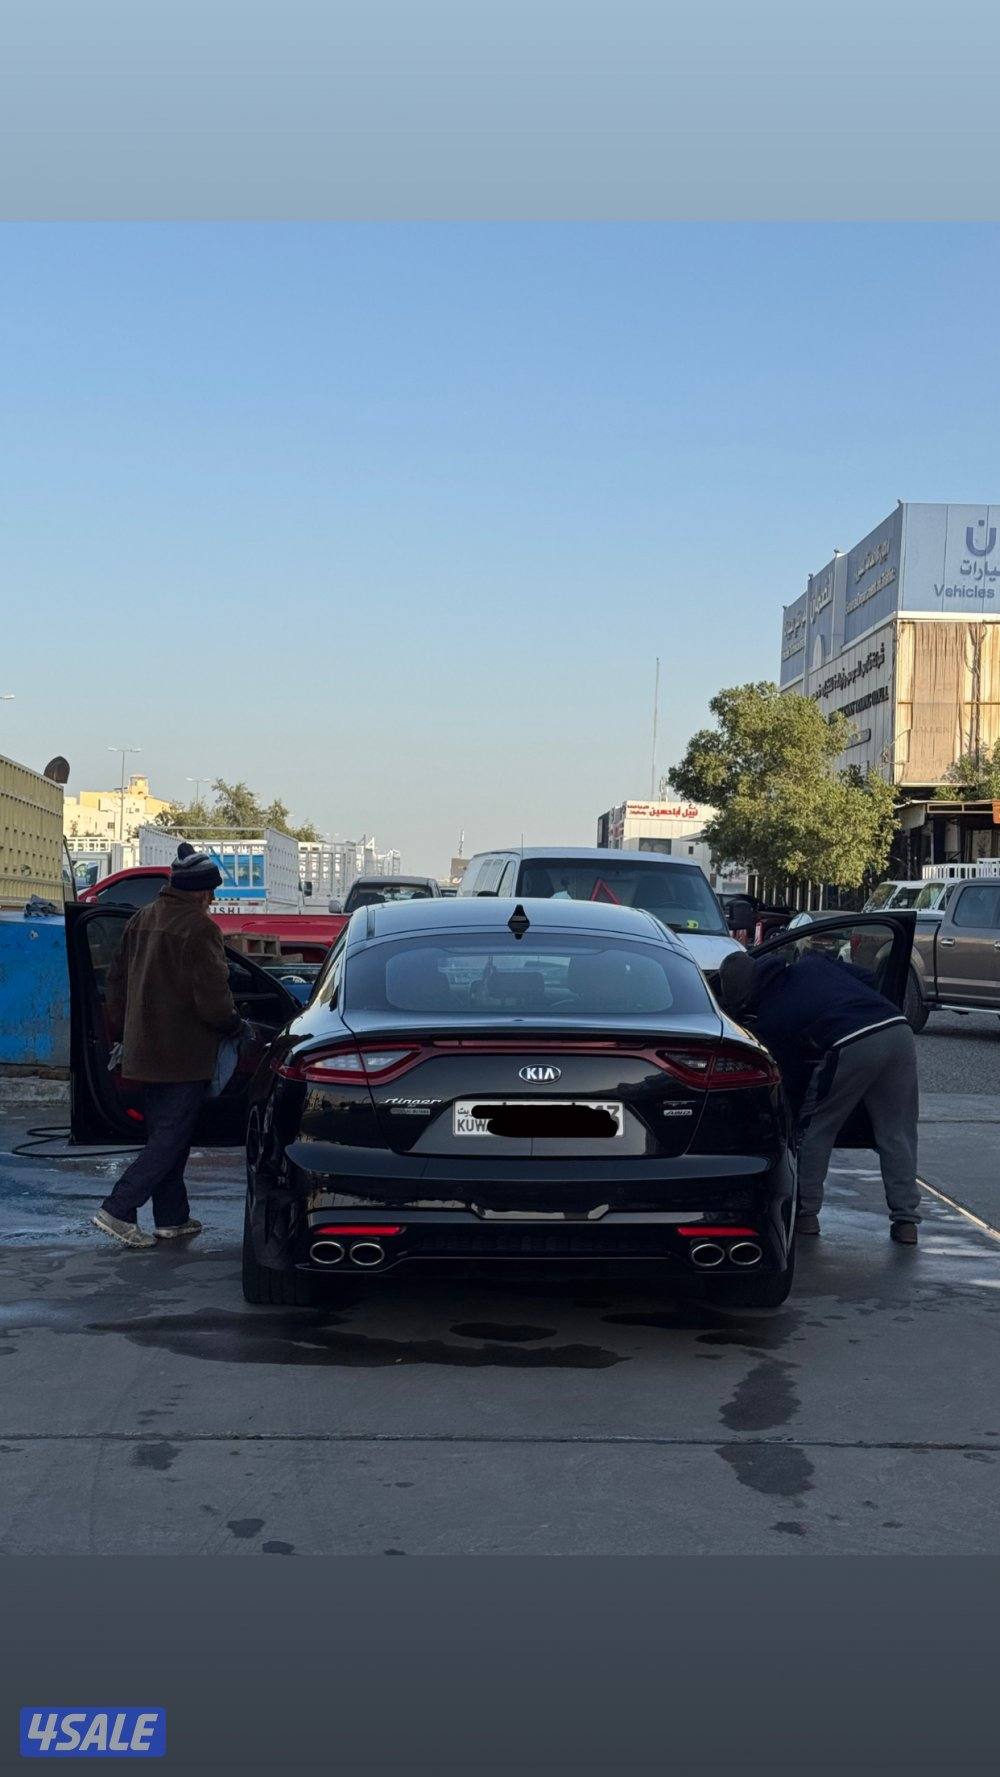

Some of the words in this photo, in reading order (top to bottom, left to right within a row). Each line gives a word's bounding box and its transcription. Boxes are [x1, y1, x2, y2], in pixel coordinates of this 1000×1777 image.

[960, 559, 1000, 581] يارات
[934, 584, 995, 598] Vehicles
[526, 1067, 555, 1080] KIA
